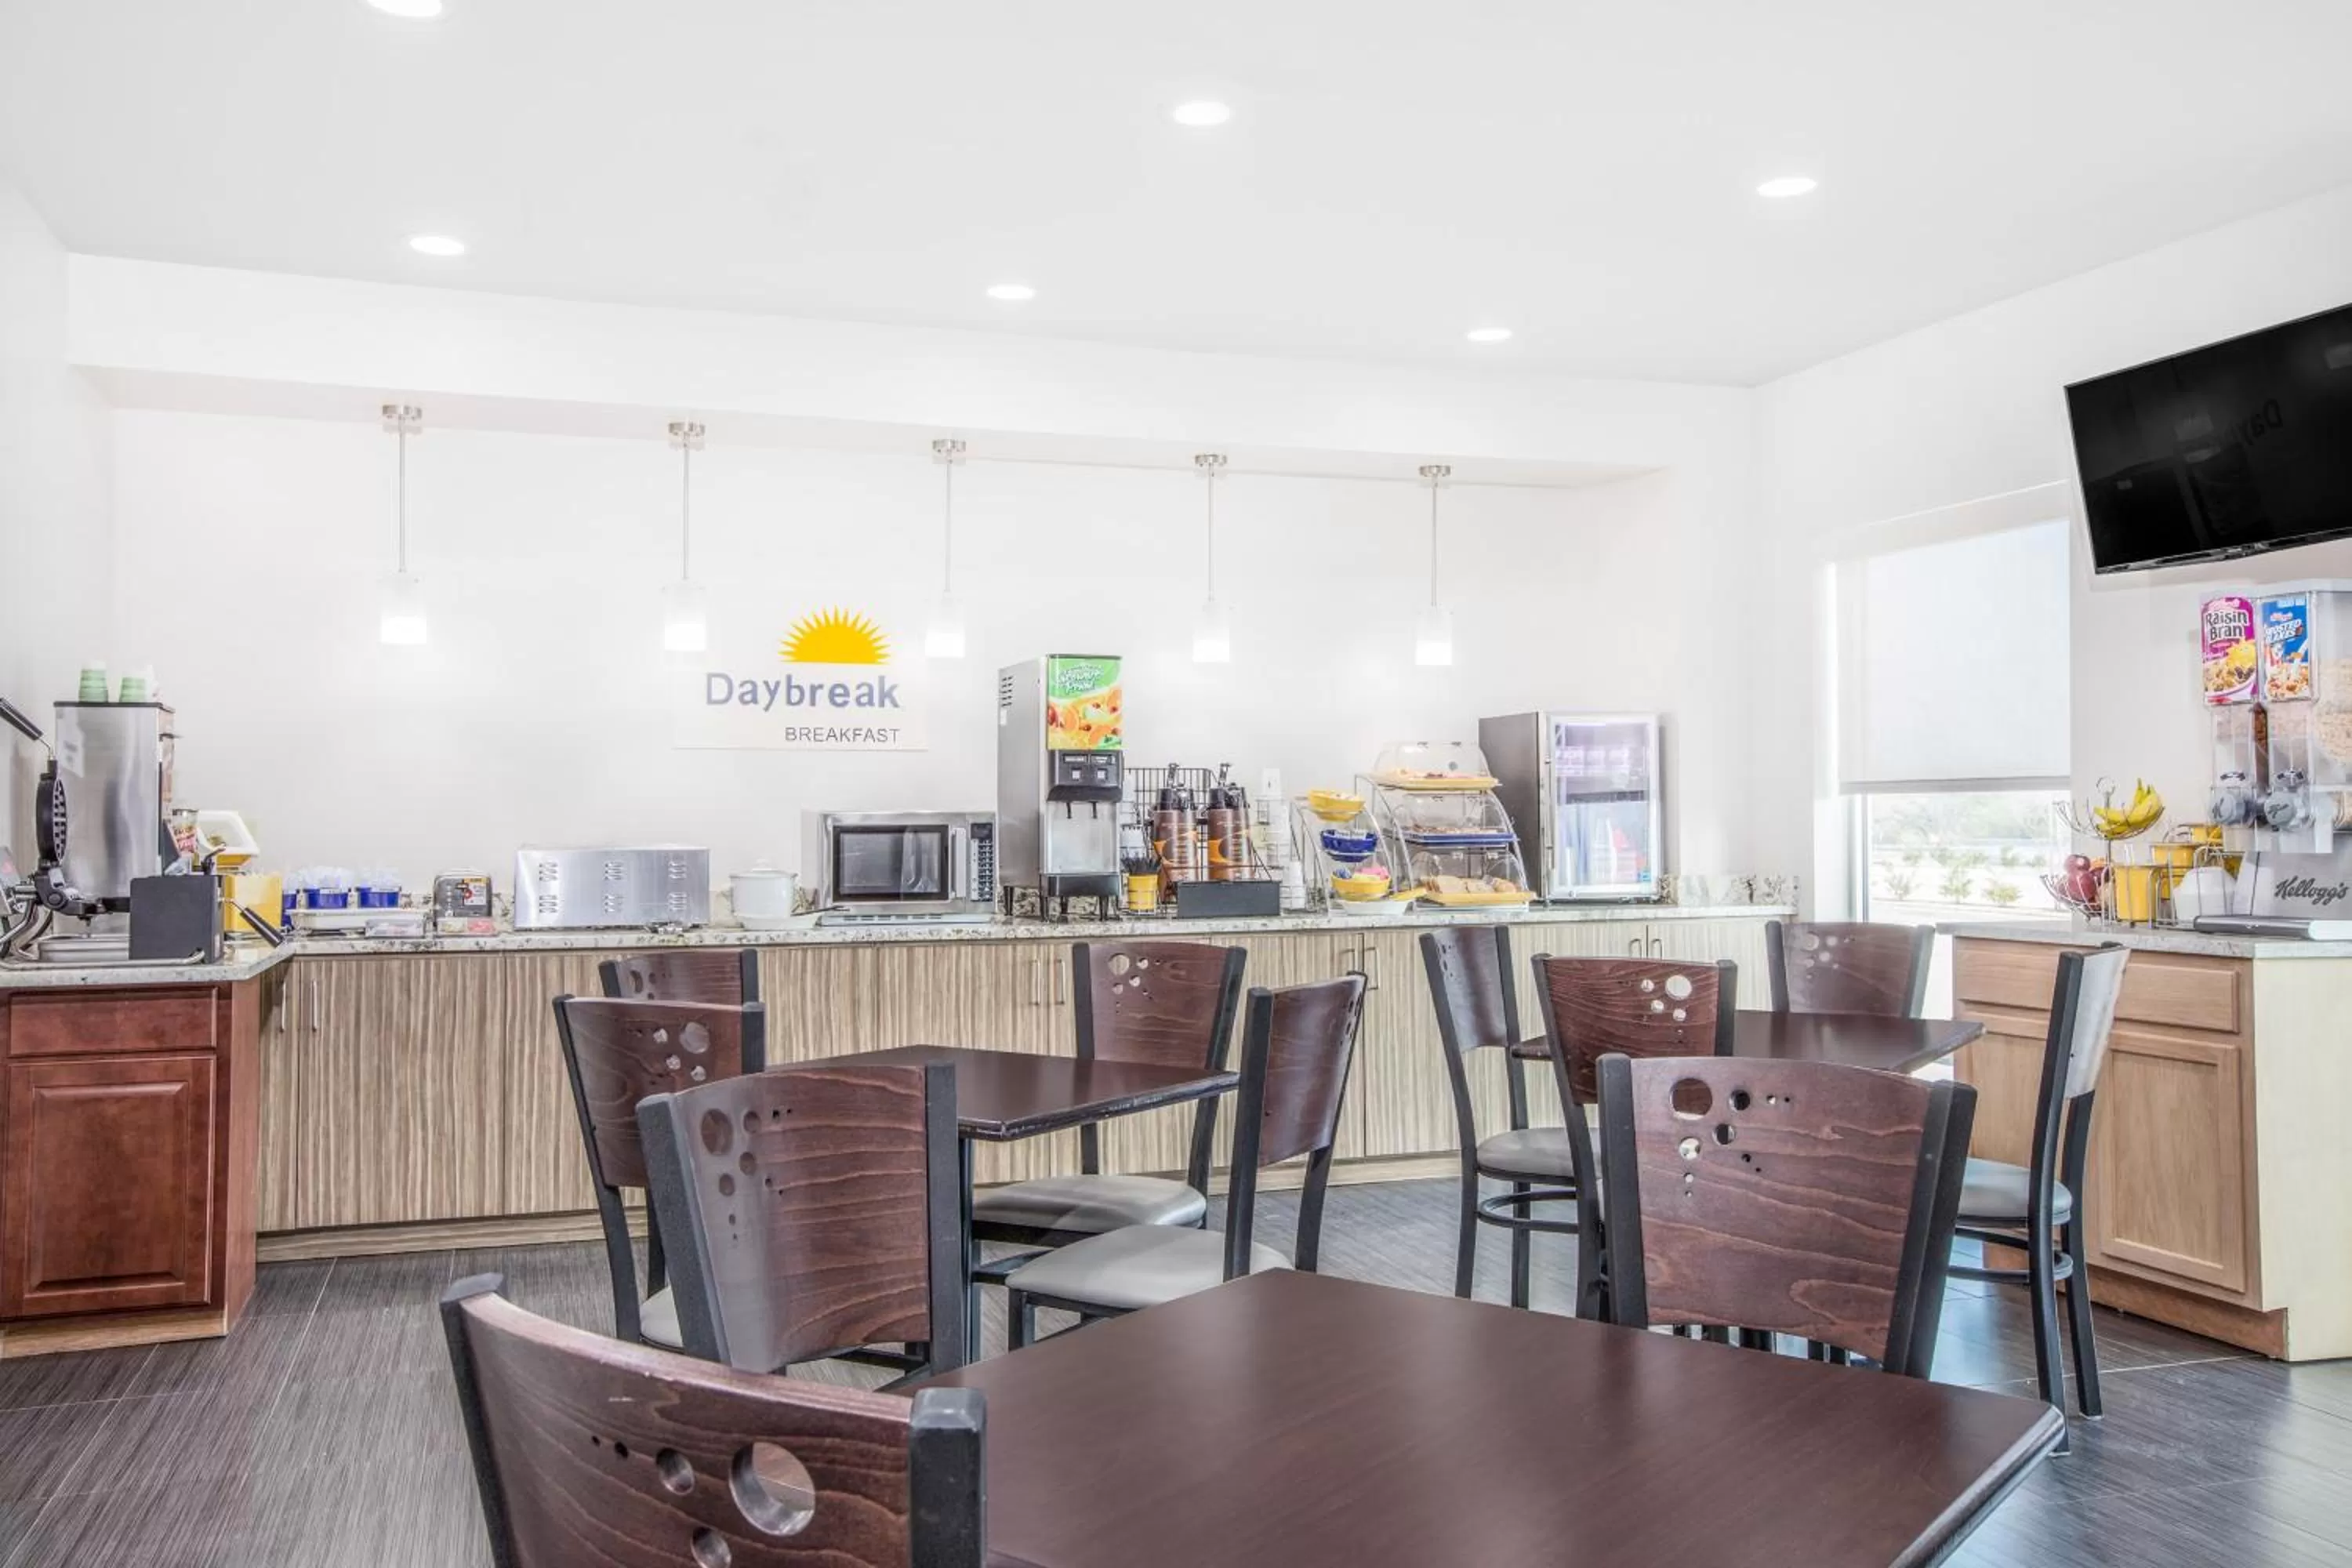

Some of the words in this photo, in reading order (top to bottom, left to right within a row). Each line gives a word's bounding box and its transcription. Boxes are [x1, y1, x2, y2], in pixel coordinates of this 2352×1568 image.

[2206, 611, 2248, 626] Raisin
[2210, 625, 2243, 641] Bran
[706, 673, 900, 712] Daybreak
[784, 727, 900, 742] BREAKFAST
[2275, 875, 2349, 906] Kellogg's
